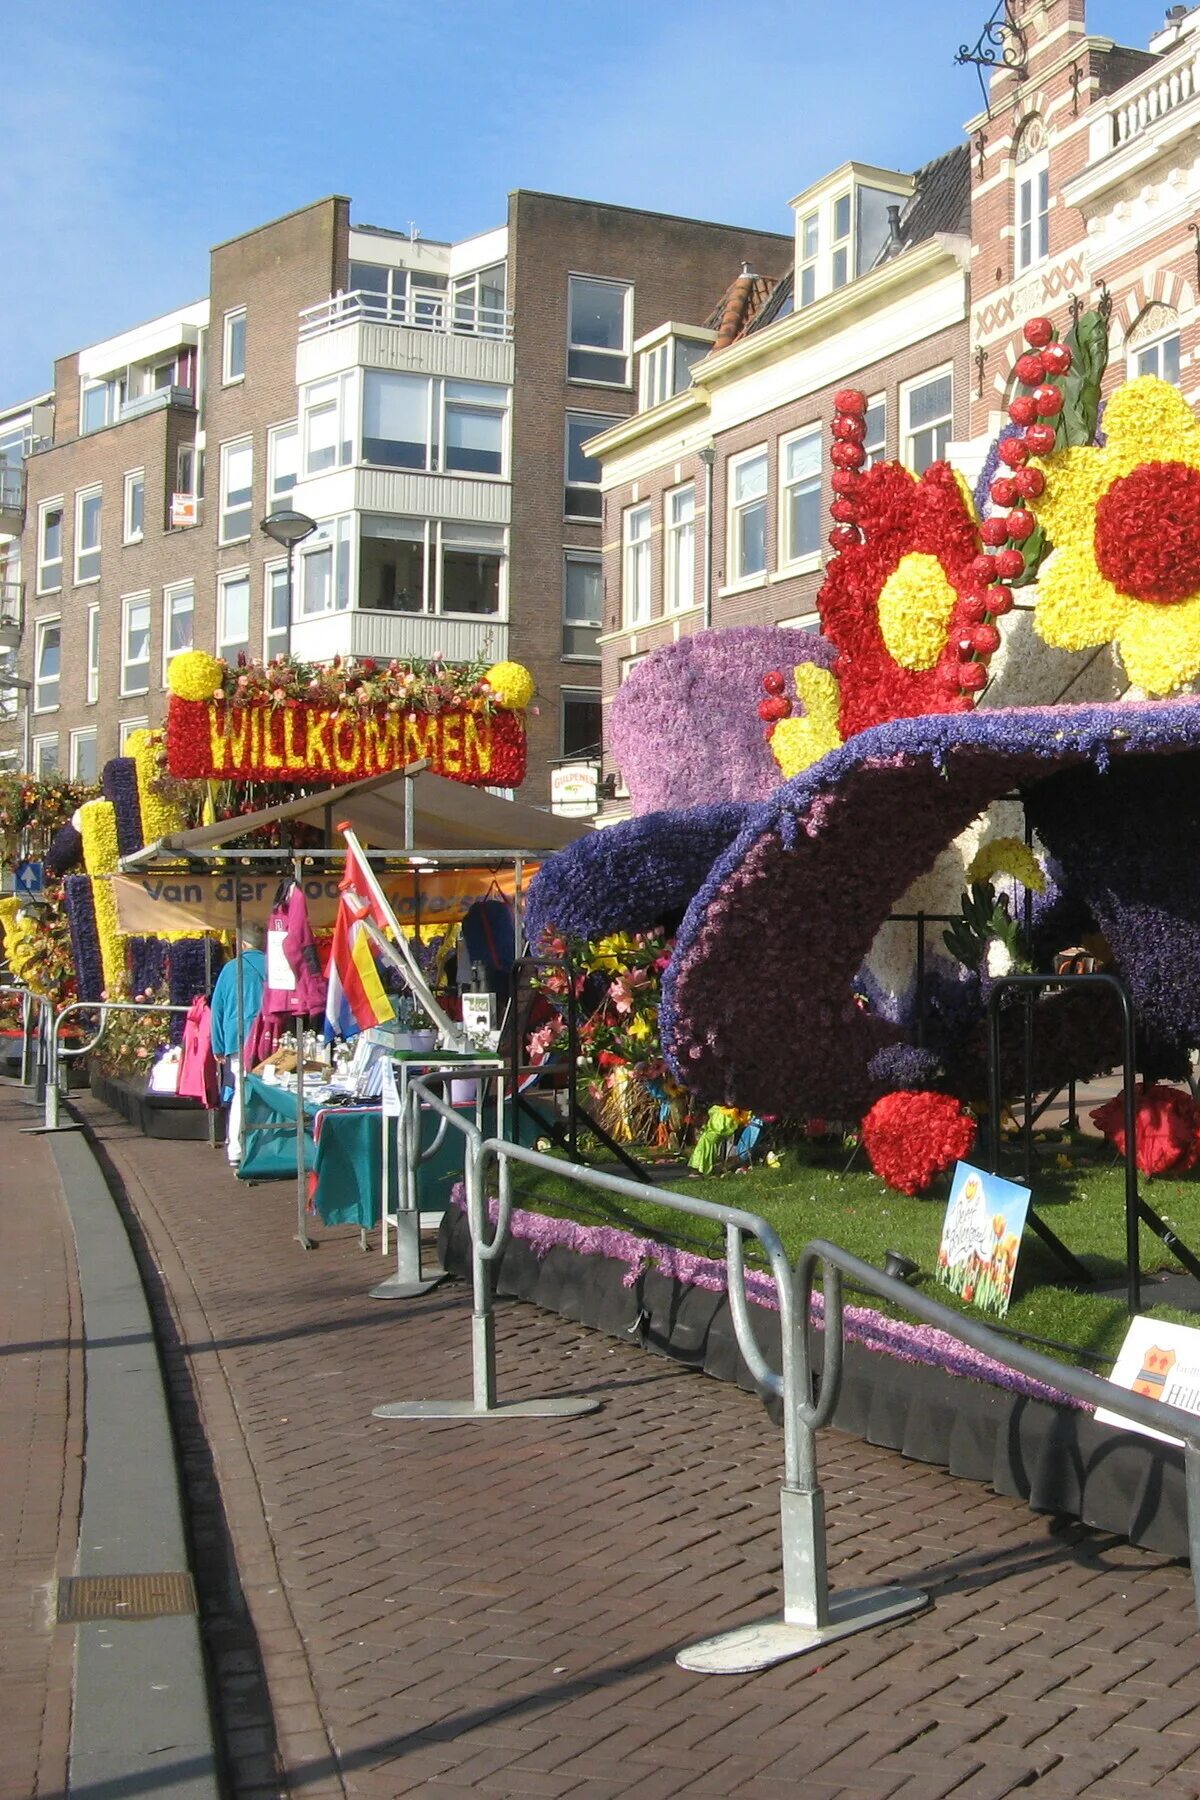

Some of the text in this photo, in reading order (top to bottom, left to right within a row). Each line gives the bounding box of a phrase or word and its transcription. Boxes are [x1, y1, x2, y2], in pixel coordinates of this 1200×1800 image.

[208, 706, 493, 775] WILLKOMMEN
[142, 879, 202, 901] Van
[215, 878, 267, 901] der
